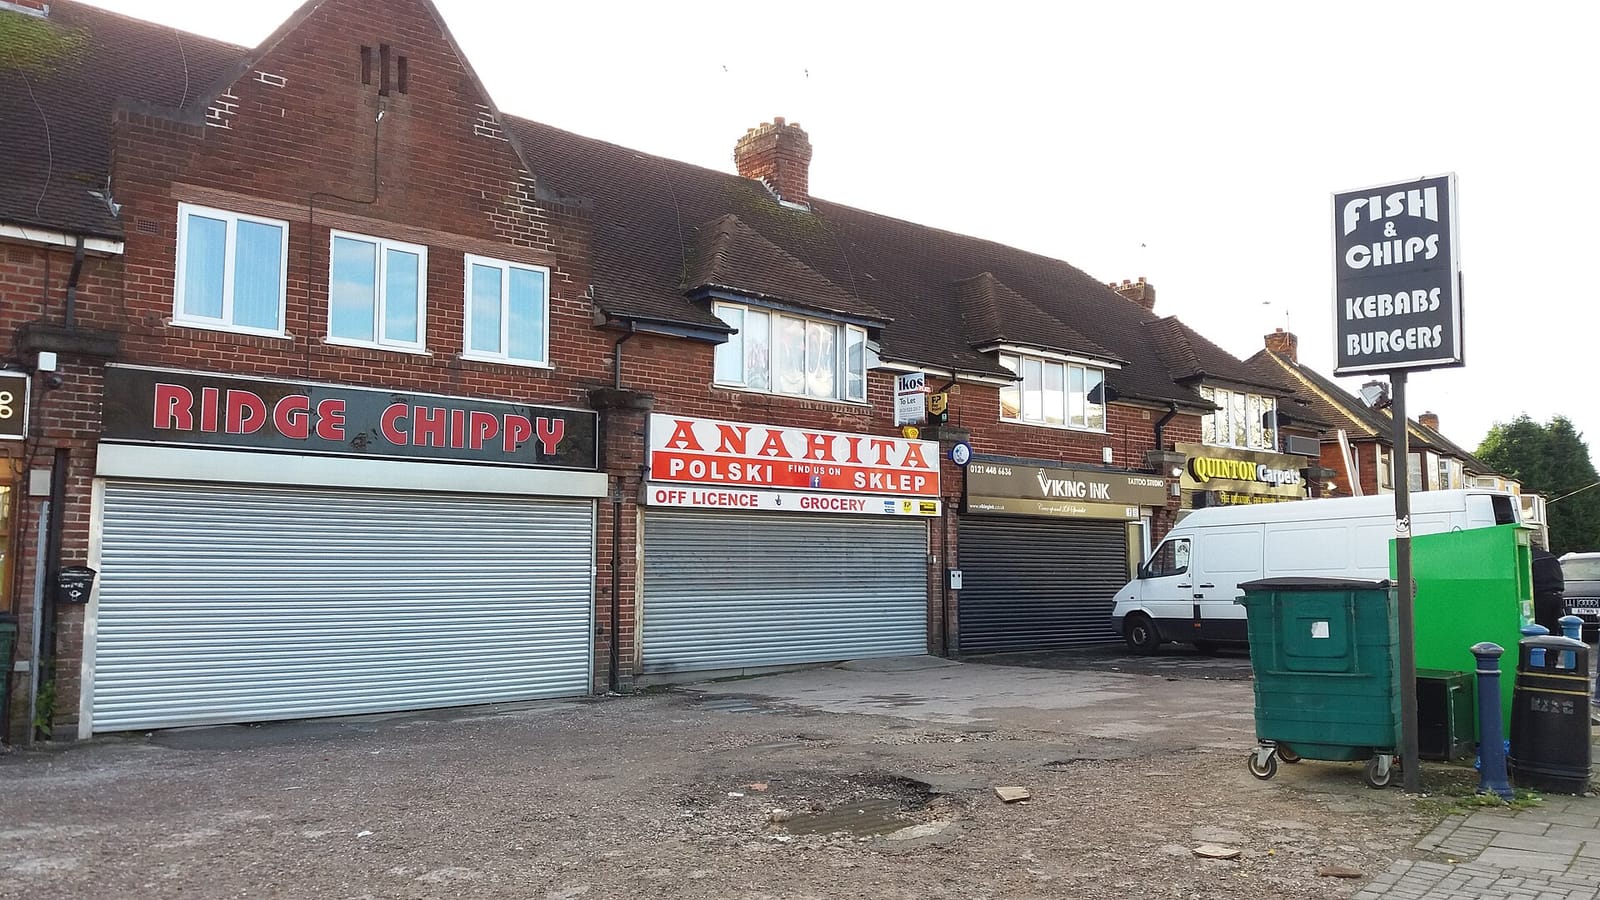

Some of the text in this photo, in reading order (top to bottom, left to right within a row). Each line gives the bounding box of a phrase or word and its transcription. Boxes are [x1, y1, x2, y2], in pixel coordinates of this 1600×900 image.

[1343, 186, 1439, 236] FISH
[1384, 221, 1398, 238] &
[1345, 233, 1440, 270] CHIPS
[1346, 287, 1441, 321] KEBABS
[1346, 324, 1443, 356] BURGERS
[898, 377, 924, 391] ikos
[153, 382, 566, 455] RIDGE CHIPPY
[664, 419, 931, 469] ANAHITA
[670, 458, 773, 483] POLSKI
[788, 464, 841, 476] FIND US ON
[854, 471, 926, 492] SKLEP
[970, 465, 985, 474] 0121
[1127, 477, 1164, 488] TATTOO STUDIO
[1195, 456, 1300, 487] QUINTON Carpets
[1037, 468, 1111, 500] VIKING INK
[655, 490, 687, 504] OFF
[692, 491, 759, 507] LICENCE
[800, 496, 867, 511] GROCERY
